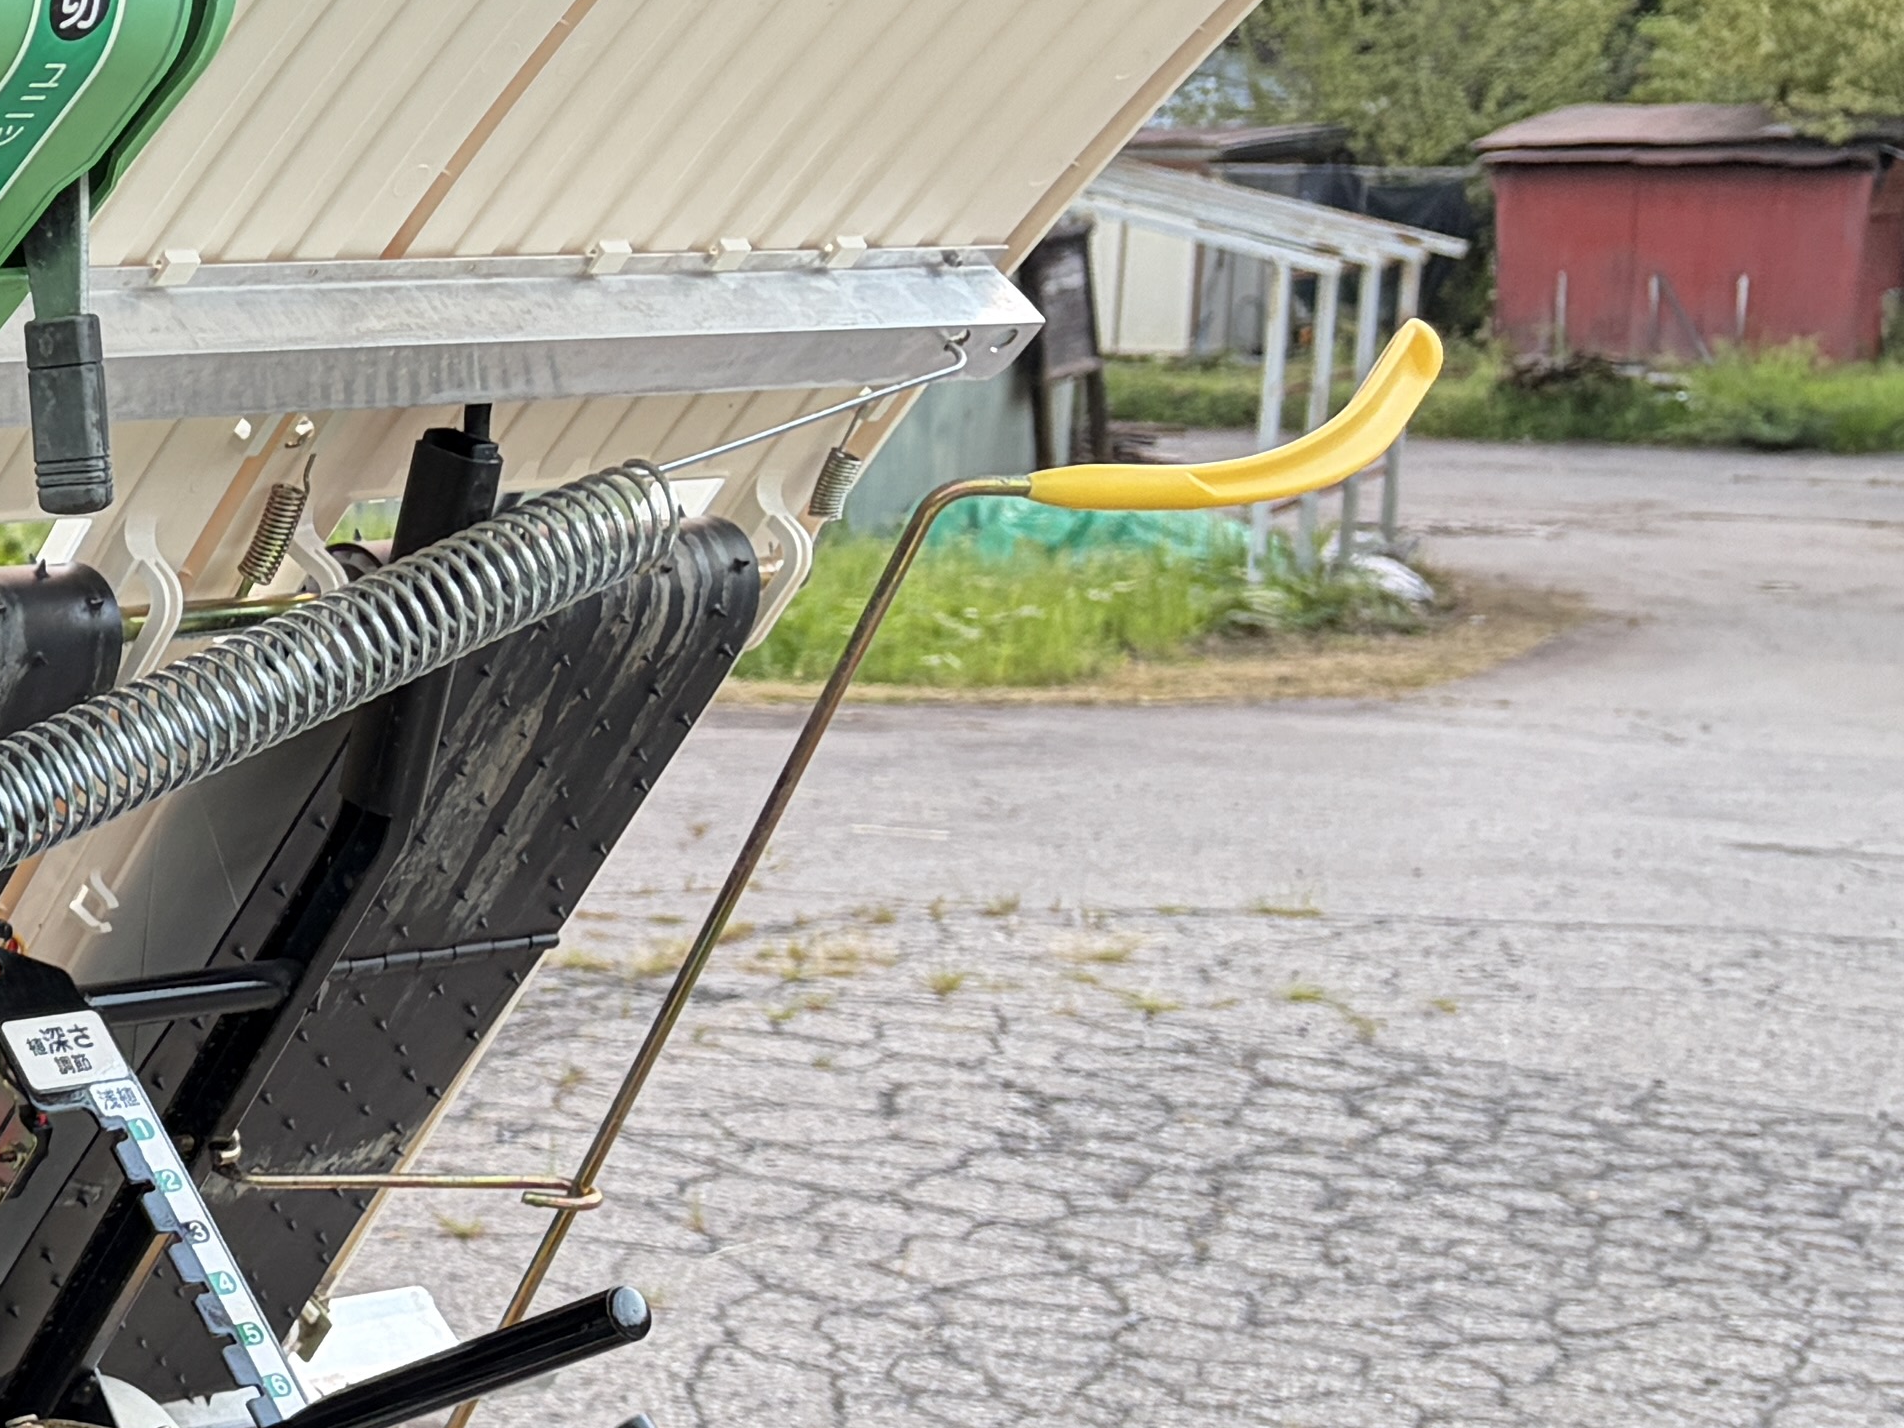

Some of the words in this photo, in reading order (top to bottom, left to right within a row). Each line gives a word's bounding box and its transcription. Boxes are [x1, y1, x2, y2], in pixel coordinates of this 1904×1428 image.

[54, 1053, 92, 1075] 調節
[135, 1119, 149, 1139] 1
[163, 1171, 180, 1190] 2
[189, 1221, 207, 1242] 3
[218, 1273, 235, 1293] 4
[244, 1324, 262, 1343] 5
[271, 1374, 288, 1395] 6
